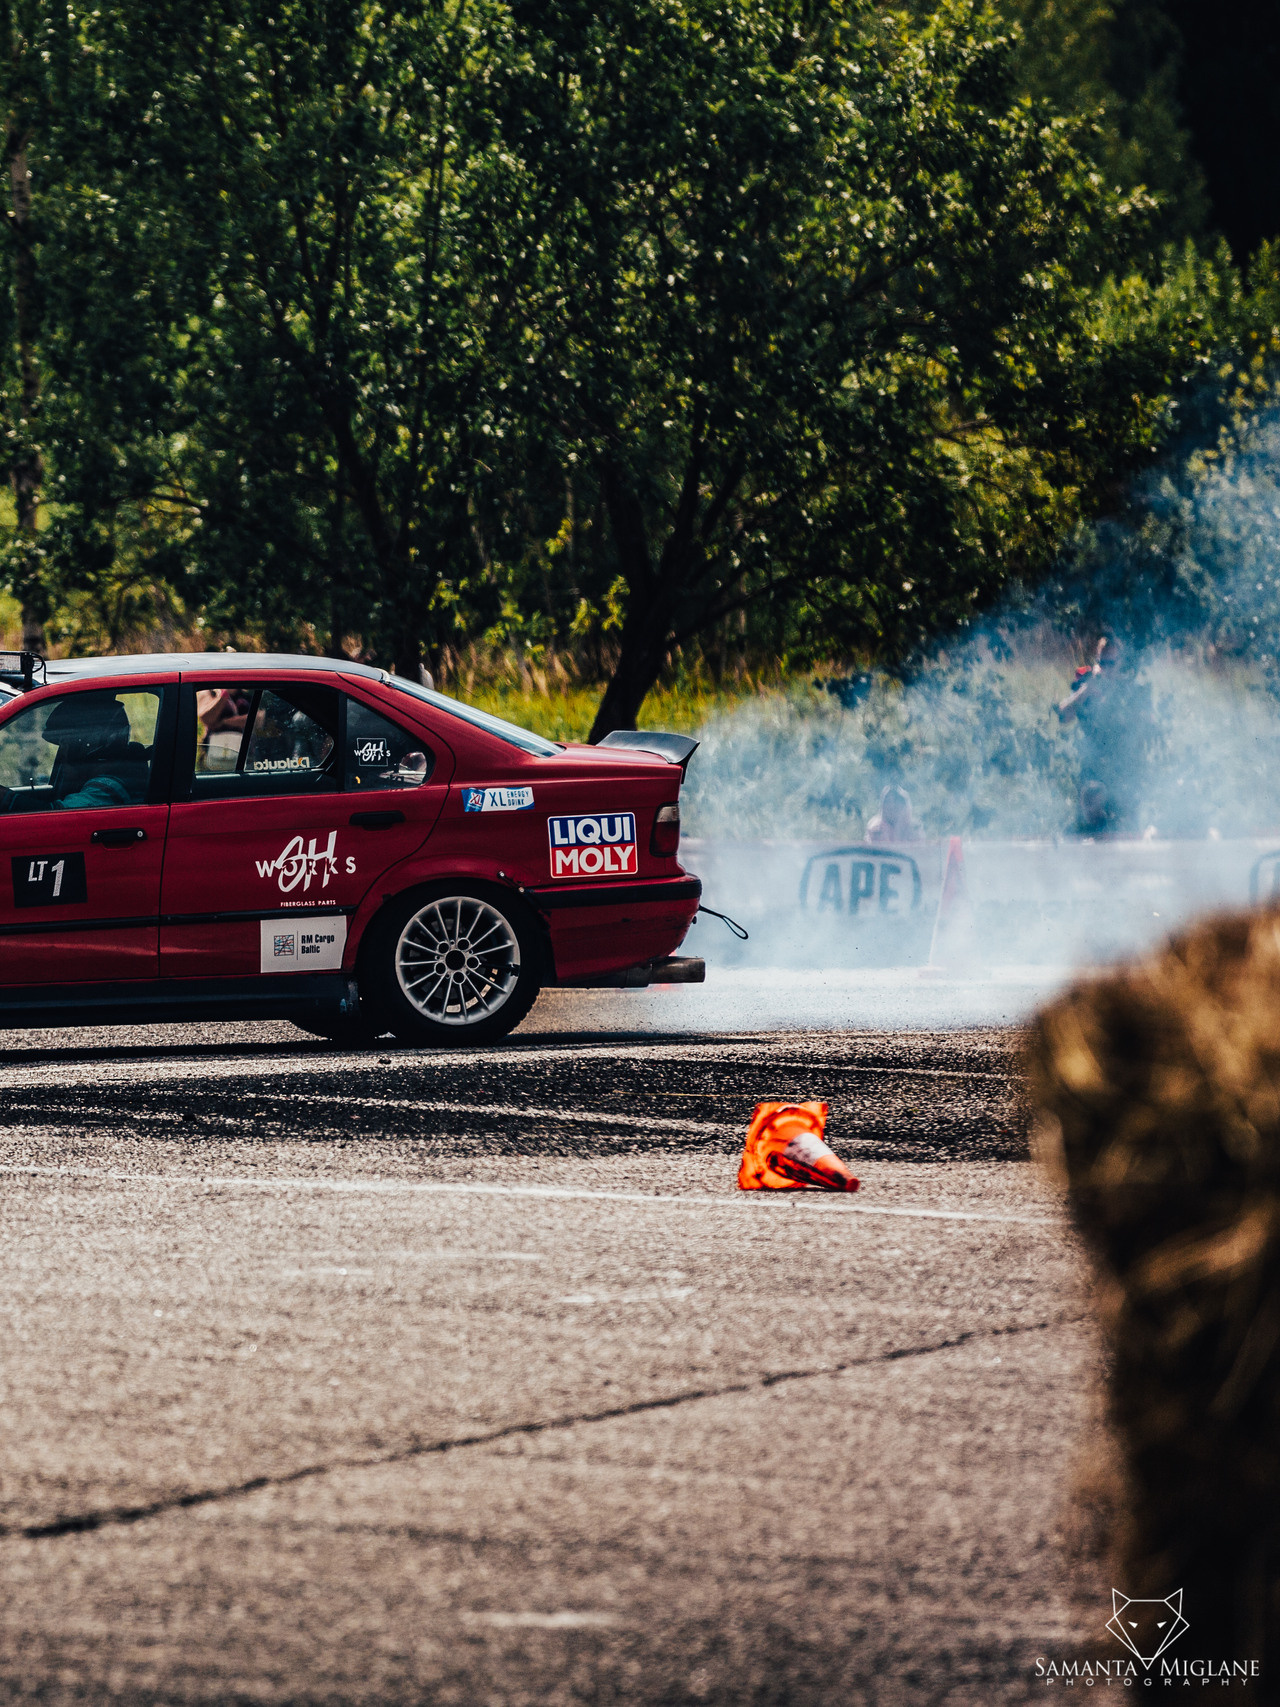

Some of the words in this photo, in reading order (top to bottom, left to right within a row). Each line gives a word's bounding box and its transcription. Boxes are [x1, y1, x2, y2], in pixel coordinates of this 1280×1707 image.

[488, 791, 507, 807] XL
[506, 790, 529, 798] ENERGY
[507, 798, 525, 807] DRINK
[553, 816, 632, 845] LIQUI
[555, 845, 634, 875] MOLY
[28, 860, 48, 882] LT
[51, 859, 65, 897] 1
[817, 861, 902, 915] APE
[301, 934, 313, 944] RM
[314, 934, 335, 944] Cargo
[301, 945, 321, 954] Baltic
